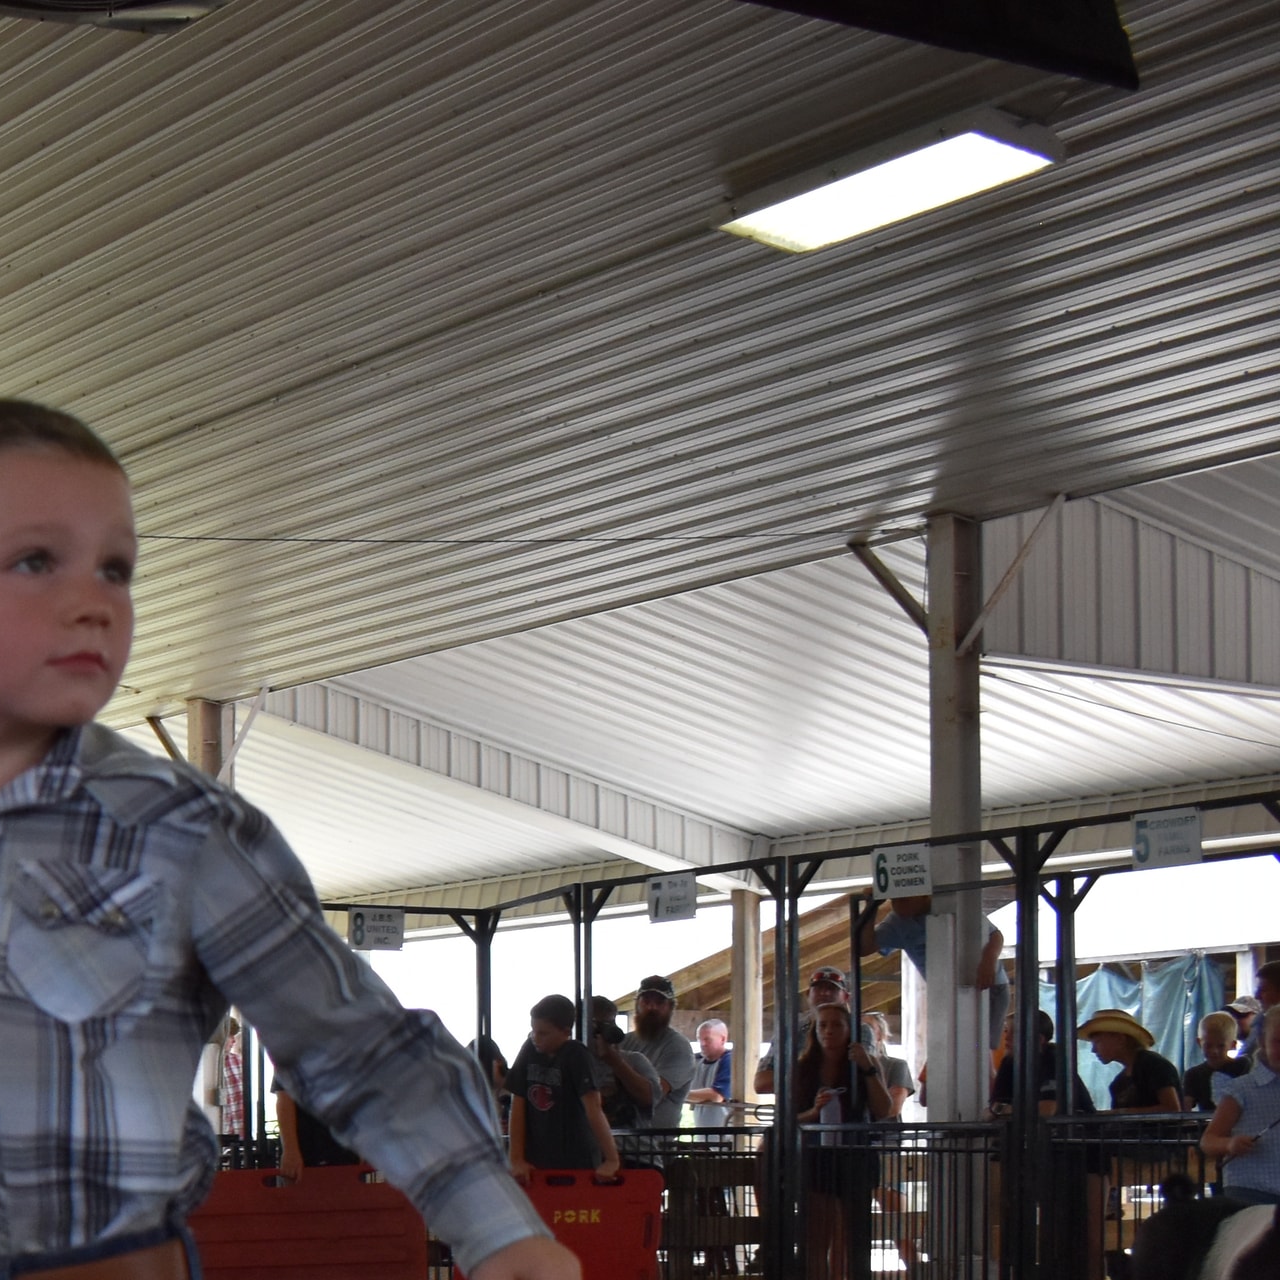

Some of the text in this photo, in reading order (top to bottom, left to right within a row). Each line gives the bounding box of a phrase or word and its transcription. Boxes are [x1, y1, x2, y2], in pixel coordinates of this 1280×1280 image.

[1135, 819, 1150, 864] 5
[896, 852, 920, 863] PORK
[875, 852, 889, 894] 6
[890, 864, 927, 876] COUNCIL
[893, 876, 925, 888] WOMEN
[352, 911, 365, 946] 8
[553, 1209, 601, 1224] PORK
